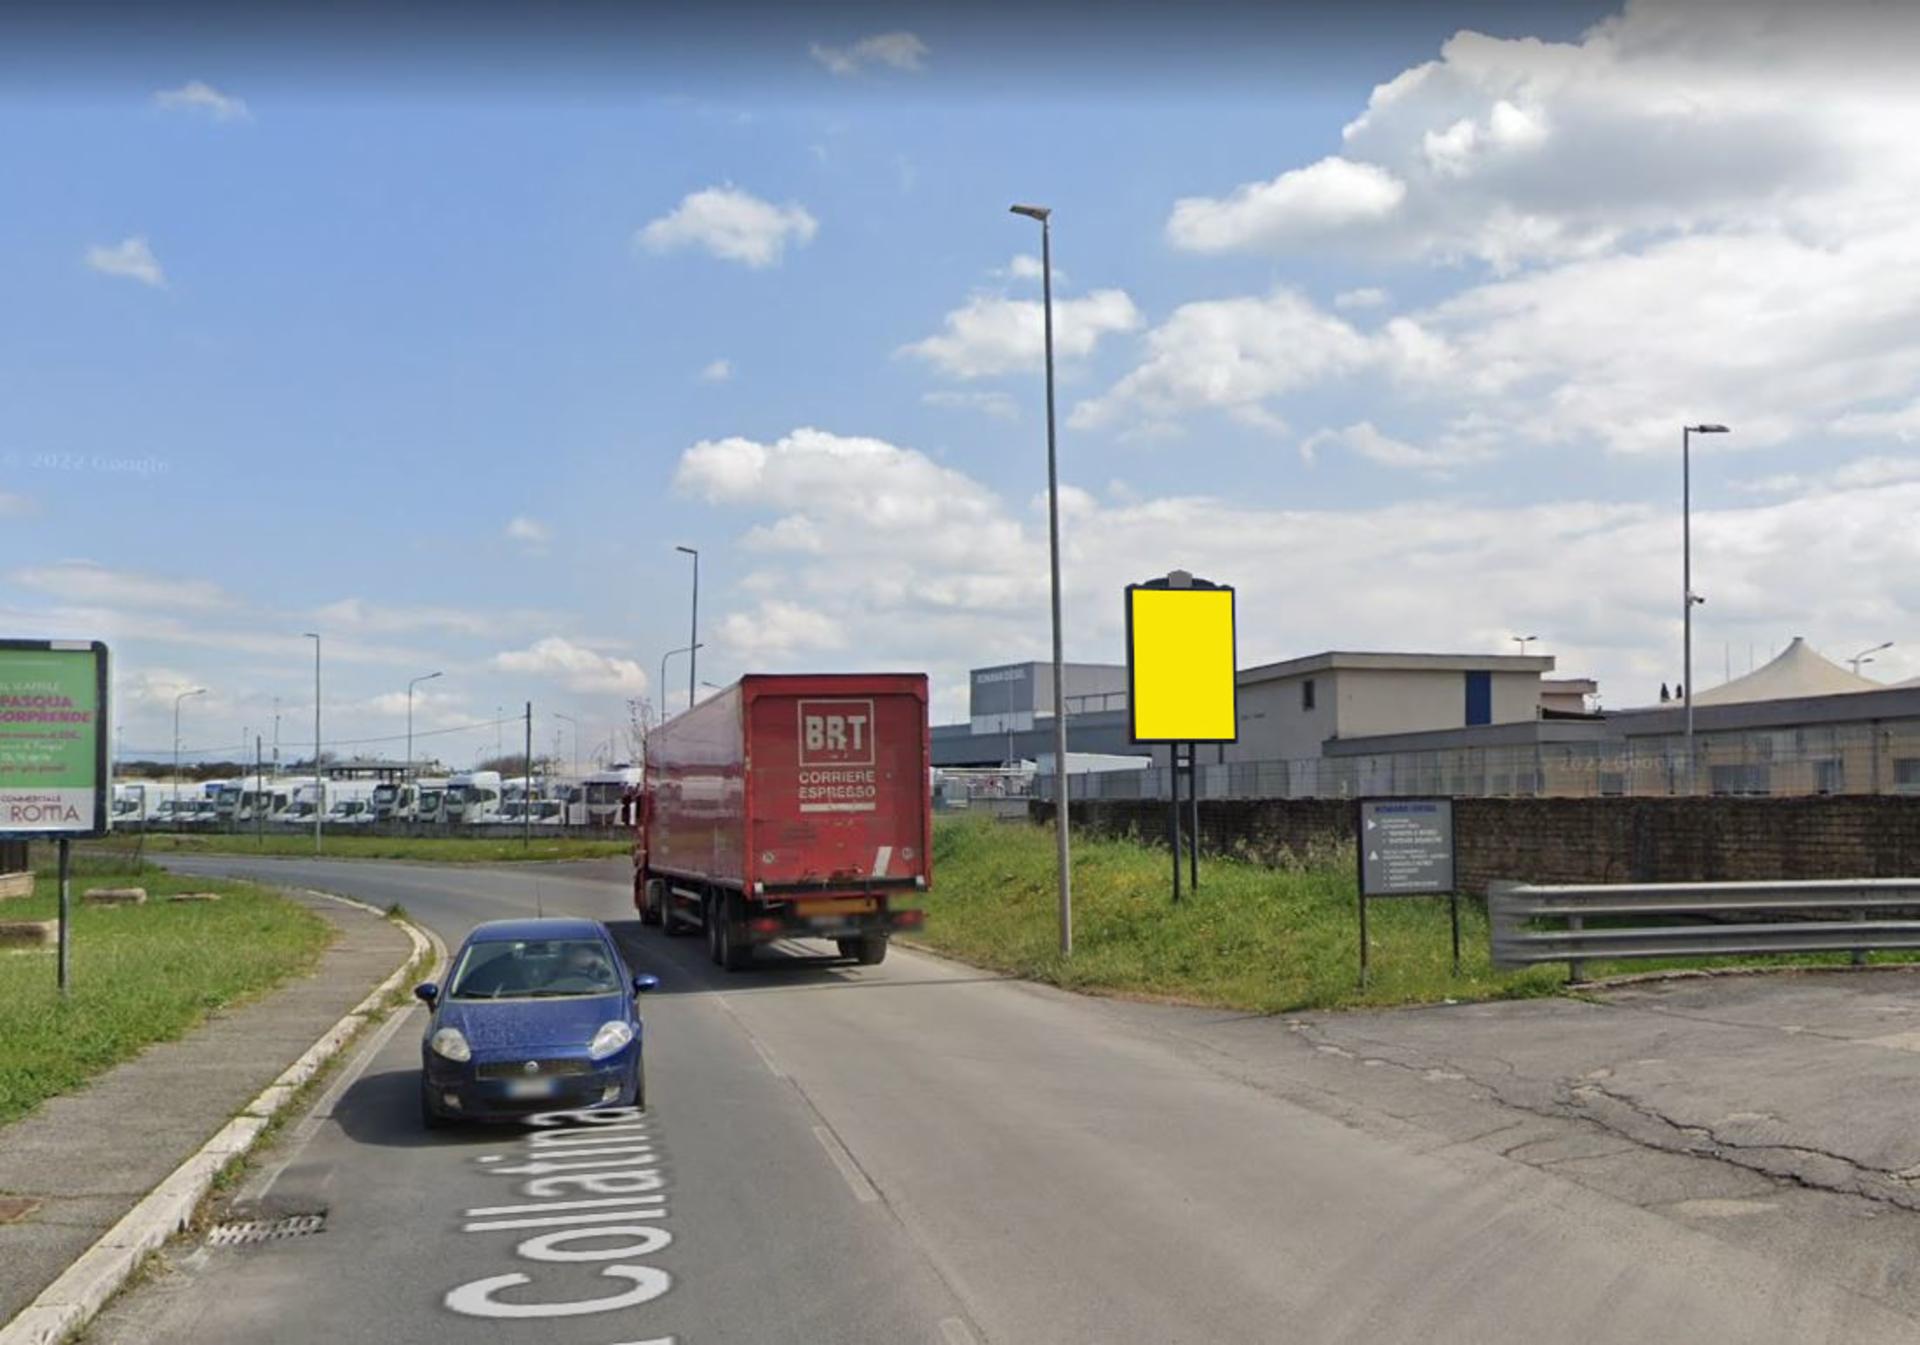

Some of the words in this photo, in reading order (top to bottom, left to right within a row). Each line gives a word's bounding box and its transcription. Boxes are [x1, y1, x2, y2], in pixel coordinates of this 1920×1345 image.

[805, 715, 867, 751] BRT
[799, 771, 875, 783] CORRIERE
[799, 785, 876, 799] ESPRESSO
[10, 804, 81, 823] ROMA
